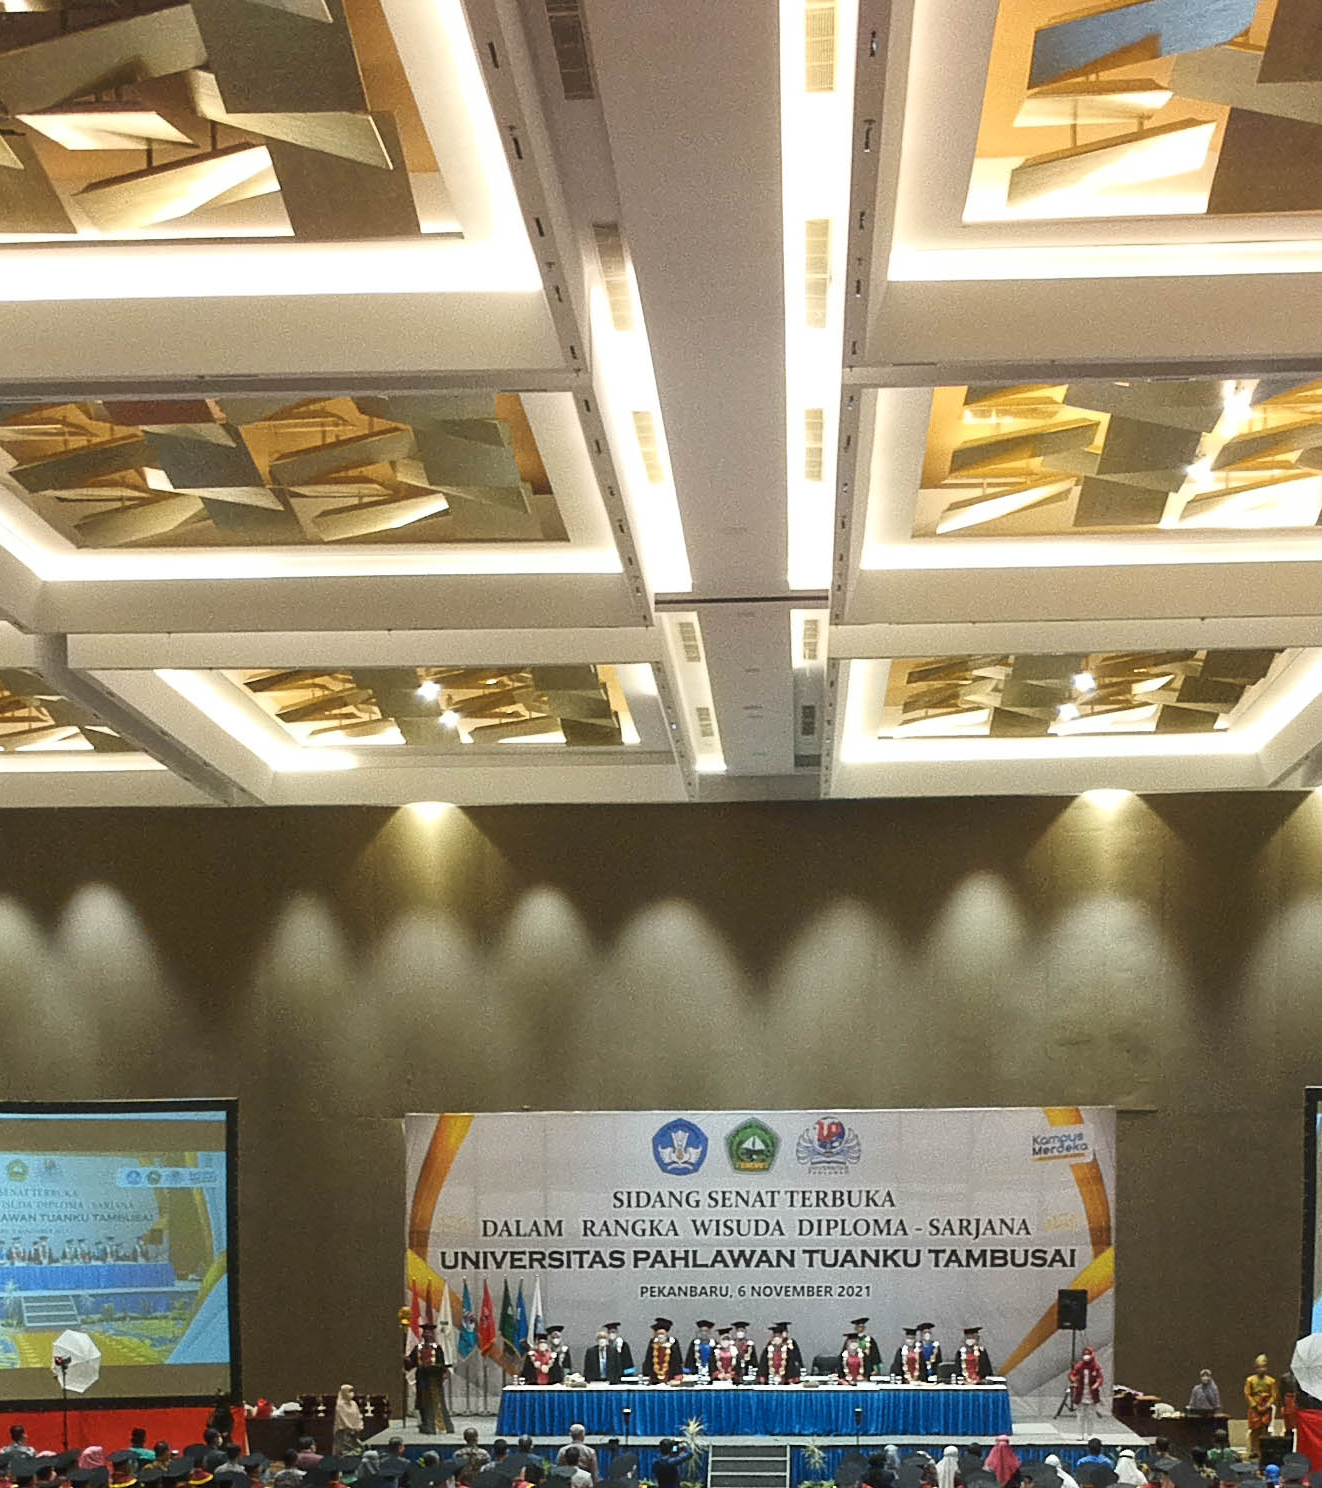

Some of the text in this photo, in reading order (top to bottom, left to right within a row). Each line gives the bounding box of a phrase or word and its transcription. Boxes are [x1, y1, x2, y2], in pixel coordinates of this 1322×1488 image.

[1032, 1132, 1084, 1146] Kampus
[1032, 1143, 1089, 1156] Merdeka
[612, 1189, 896, 1209] SIDANG SENAT TERBUKA
[40, 1213, 90, 1222] TUANKU
[481, 1219, 564, 1238] DALAM
[582, 1218, 680, 1238] RANGKA
[692, 1218, 786, 1237] WISUDA
[797, 1218, 909, 1237] DIPLOMA
[928, 1218, 1032, 1240] SARJANA
[440, 1248, 1077, 1269] UNIVERSITAS PAHLAWAN TUANKU TAMBUSAI
[640, 1285, 871, 1299] PEKANBARU, 6 NOVEMBER 2021
